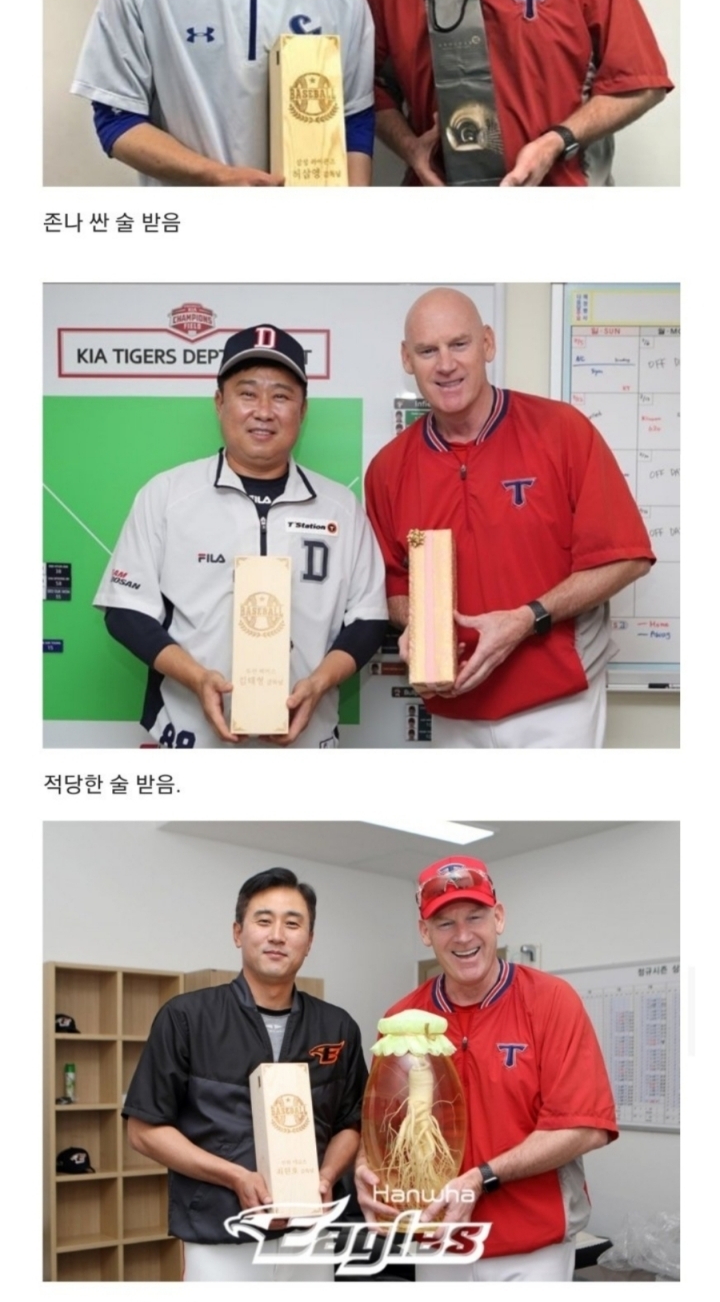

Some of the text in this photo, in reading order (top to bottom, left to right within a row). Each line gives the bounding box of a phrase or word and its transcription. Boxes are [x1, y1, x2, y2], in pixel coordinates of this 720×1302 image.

[289, 87, 336, 100] BASEBALL
[44, 212, 180, 233] 존나 싼 술 받음
[171, 313, 213, 325] CHAMPIONS
[254, 327, 276, 348] D
[77, 348, 107, 365] KIA
[112, 348, 177, 365] TIGERS
[501, 477, 537, 508] T
[198, 553, 226, 564] FILA
[301, 538, 330, 584] D
[44, 774, 180, 795] 적당한 술 받음.
[496, 1042, 529, 1069] T
